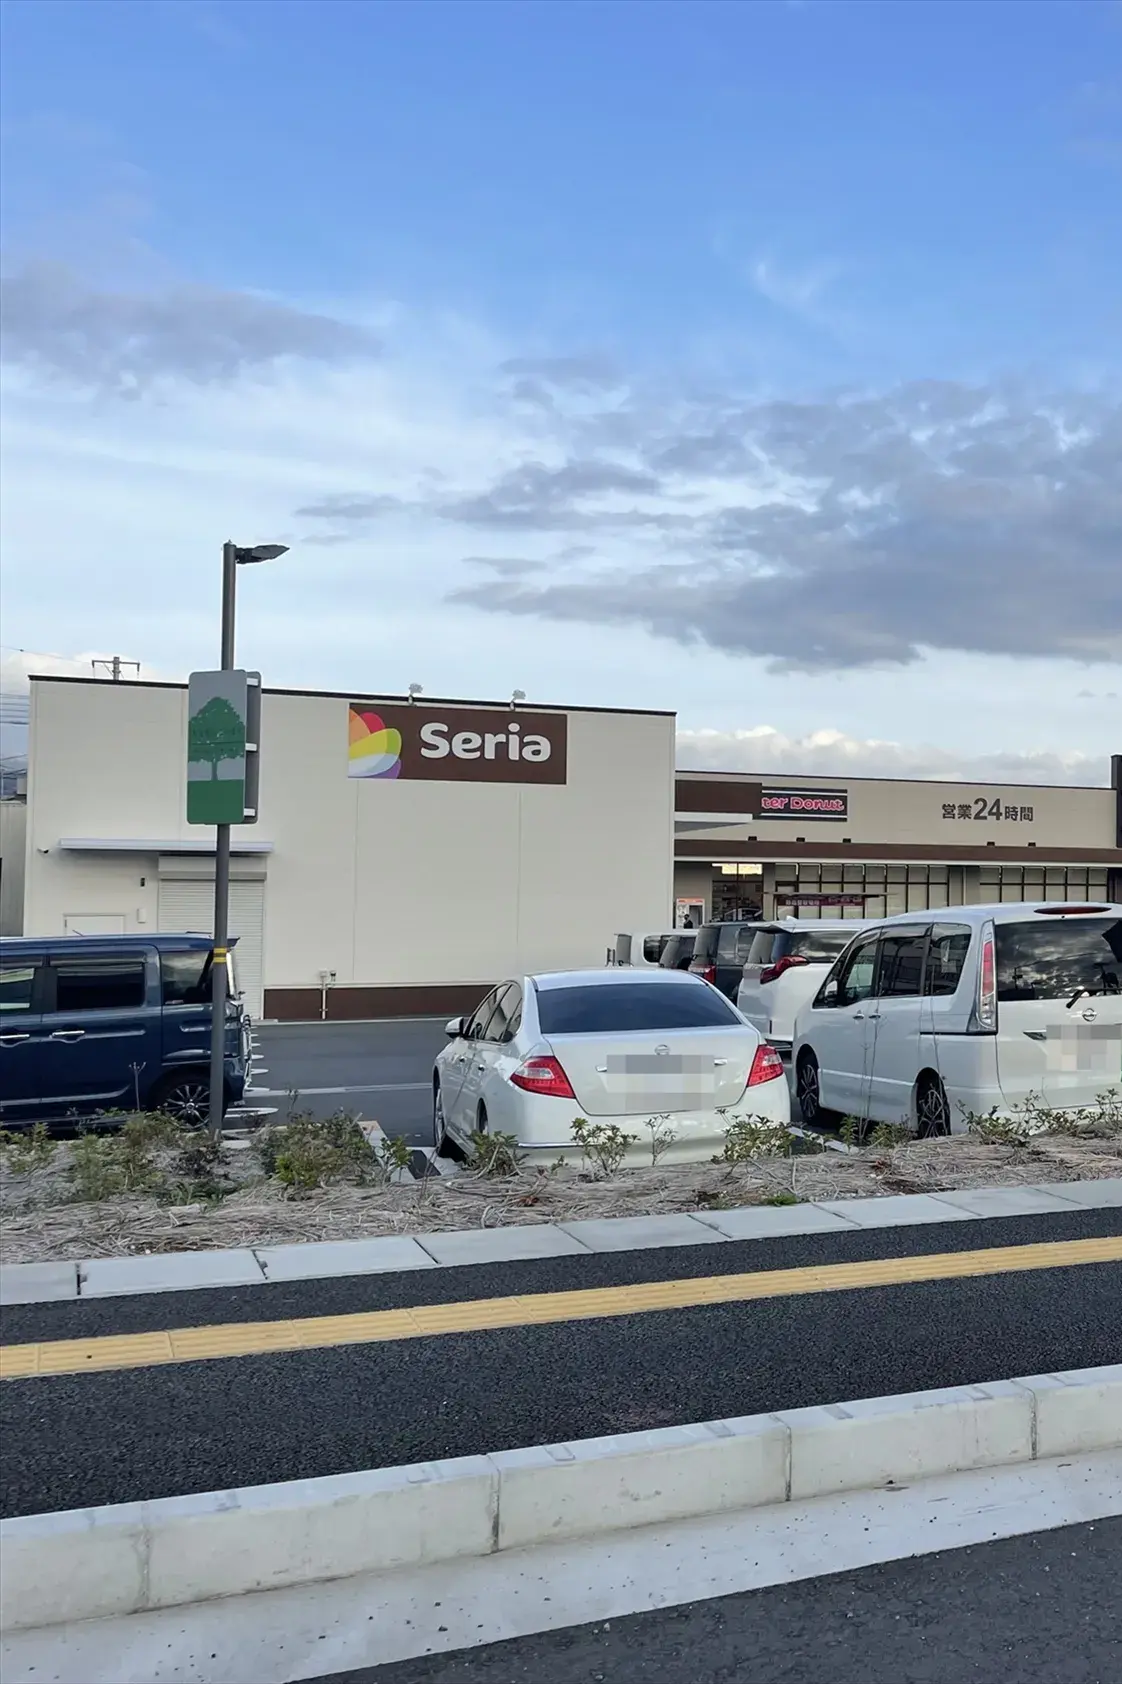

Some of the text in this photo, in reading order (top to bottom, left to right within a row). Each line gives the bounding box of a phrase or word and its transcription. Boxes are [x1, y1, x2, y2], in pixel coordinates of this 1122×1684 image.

[420, 722, 551, 762] Seria
[790, 797, 844, 811] Donut
[941, 797, 1034, 821] 営業24時間
